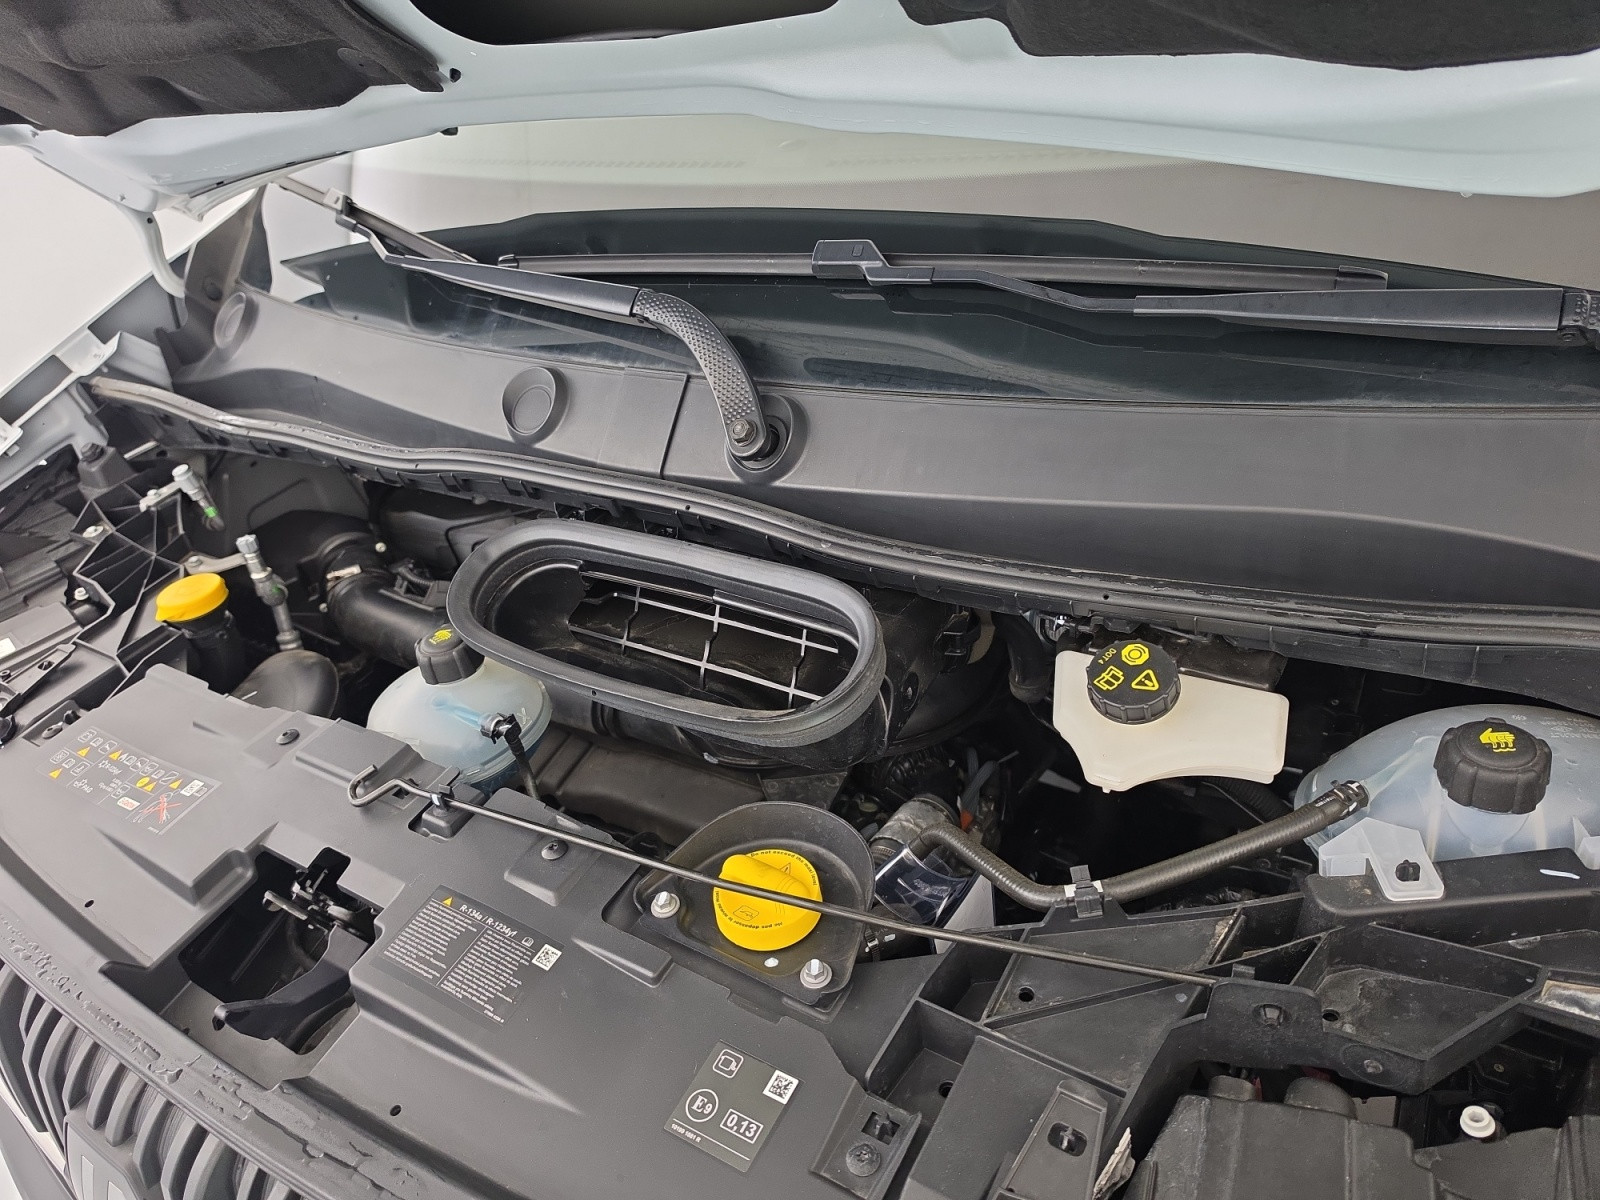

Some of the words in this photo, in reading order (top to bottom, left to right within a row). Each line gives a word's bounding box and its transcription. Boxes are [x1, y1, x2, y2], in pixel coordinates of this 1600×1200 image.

[1102, 648, 1117, 661] DOT
[804, 864, 812, 874] maxi
[460, 904, 483, 920] R-134a
[487, 918, 518, 936] R-1234yf
[726, 1114, 756, 1137] 0,13
